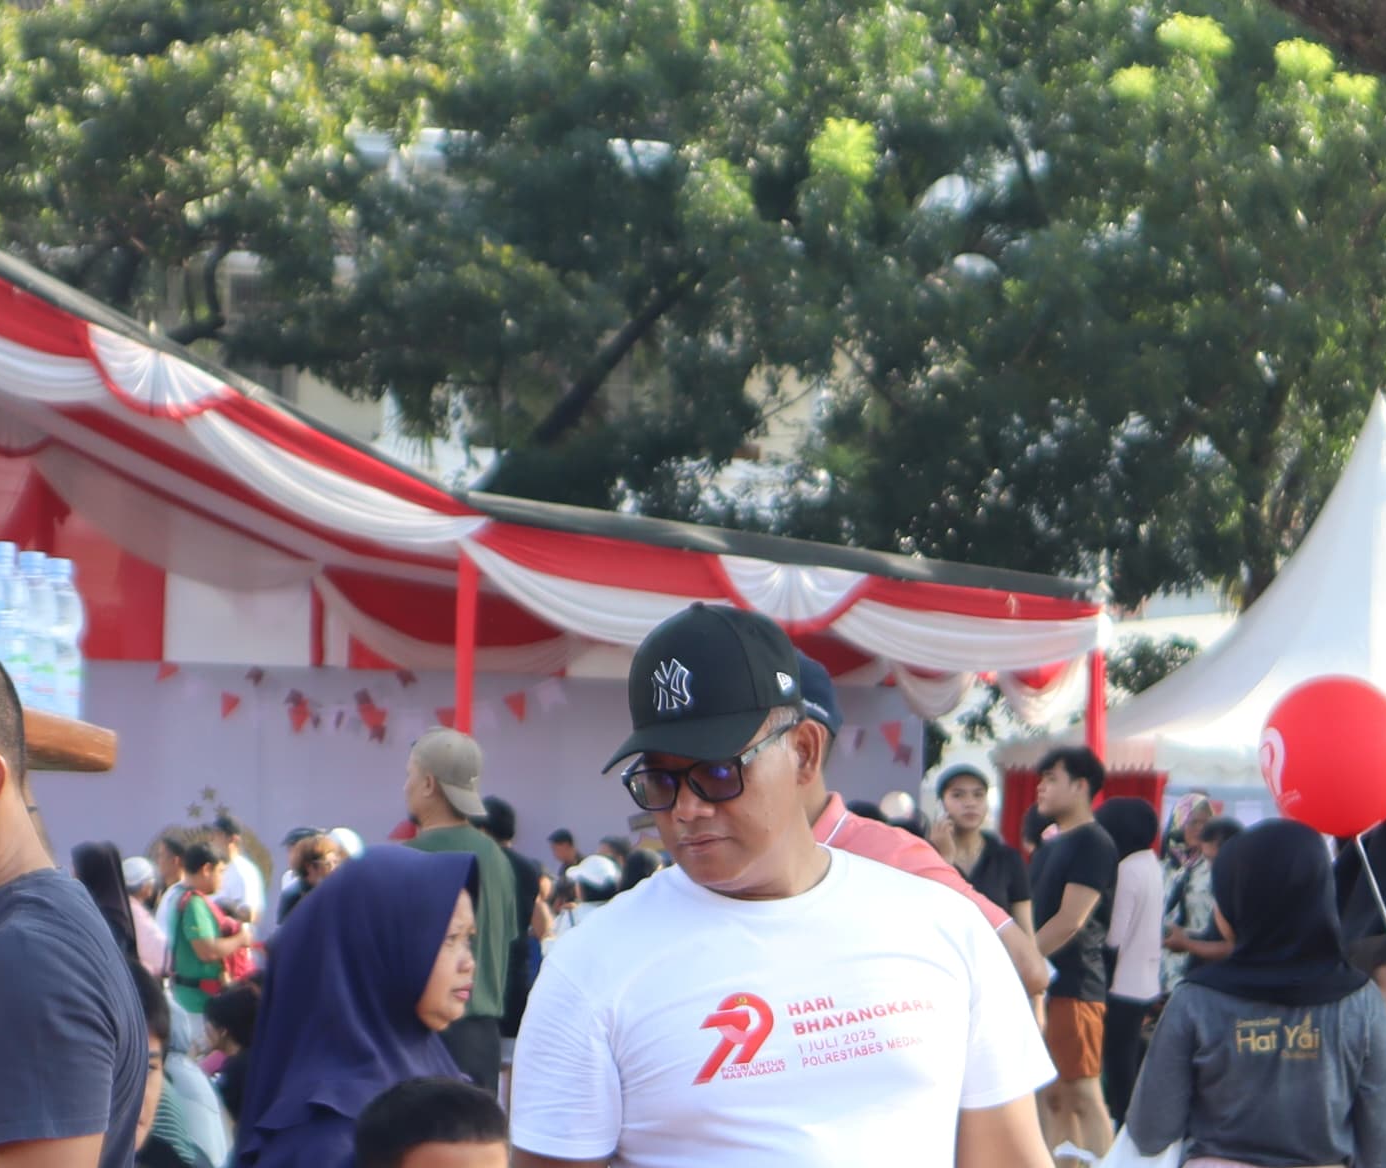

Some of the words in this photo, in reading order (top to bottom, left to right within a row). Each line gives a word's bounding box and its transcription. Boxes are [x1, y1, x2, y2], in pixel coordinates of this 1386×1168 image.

[787, 996, 835, 1017] HARI
[793, 1000, 935, 1036] BHAYANGKARA
[809, 1037, 838, 1053] JULI
[844, 1029, 876, 1046] 2025
[1236, 1028, 1278, 1053] Hat
[1284, 1024, 1320, 1049] Yai
[802, 1043, 883, 1068] POLRESTABES
